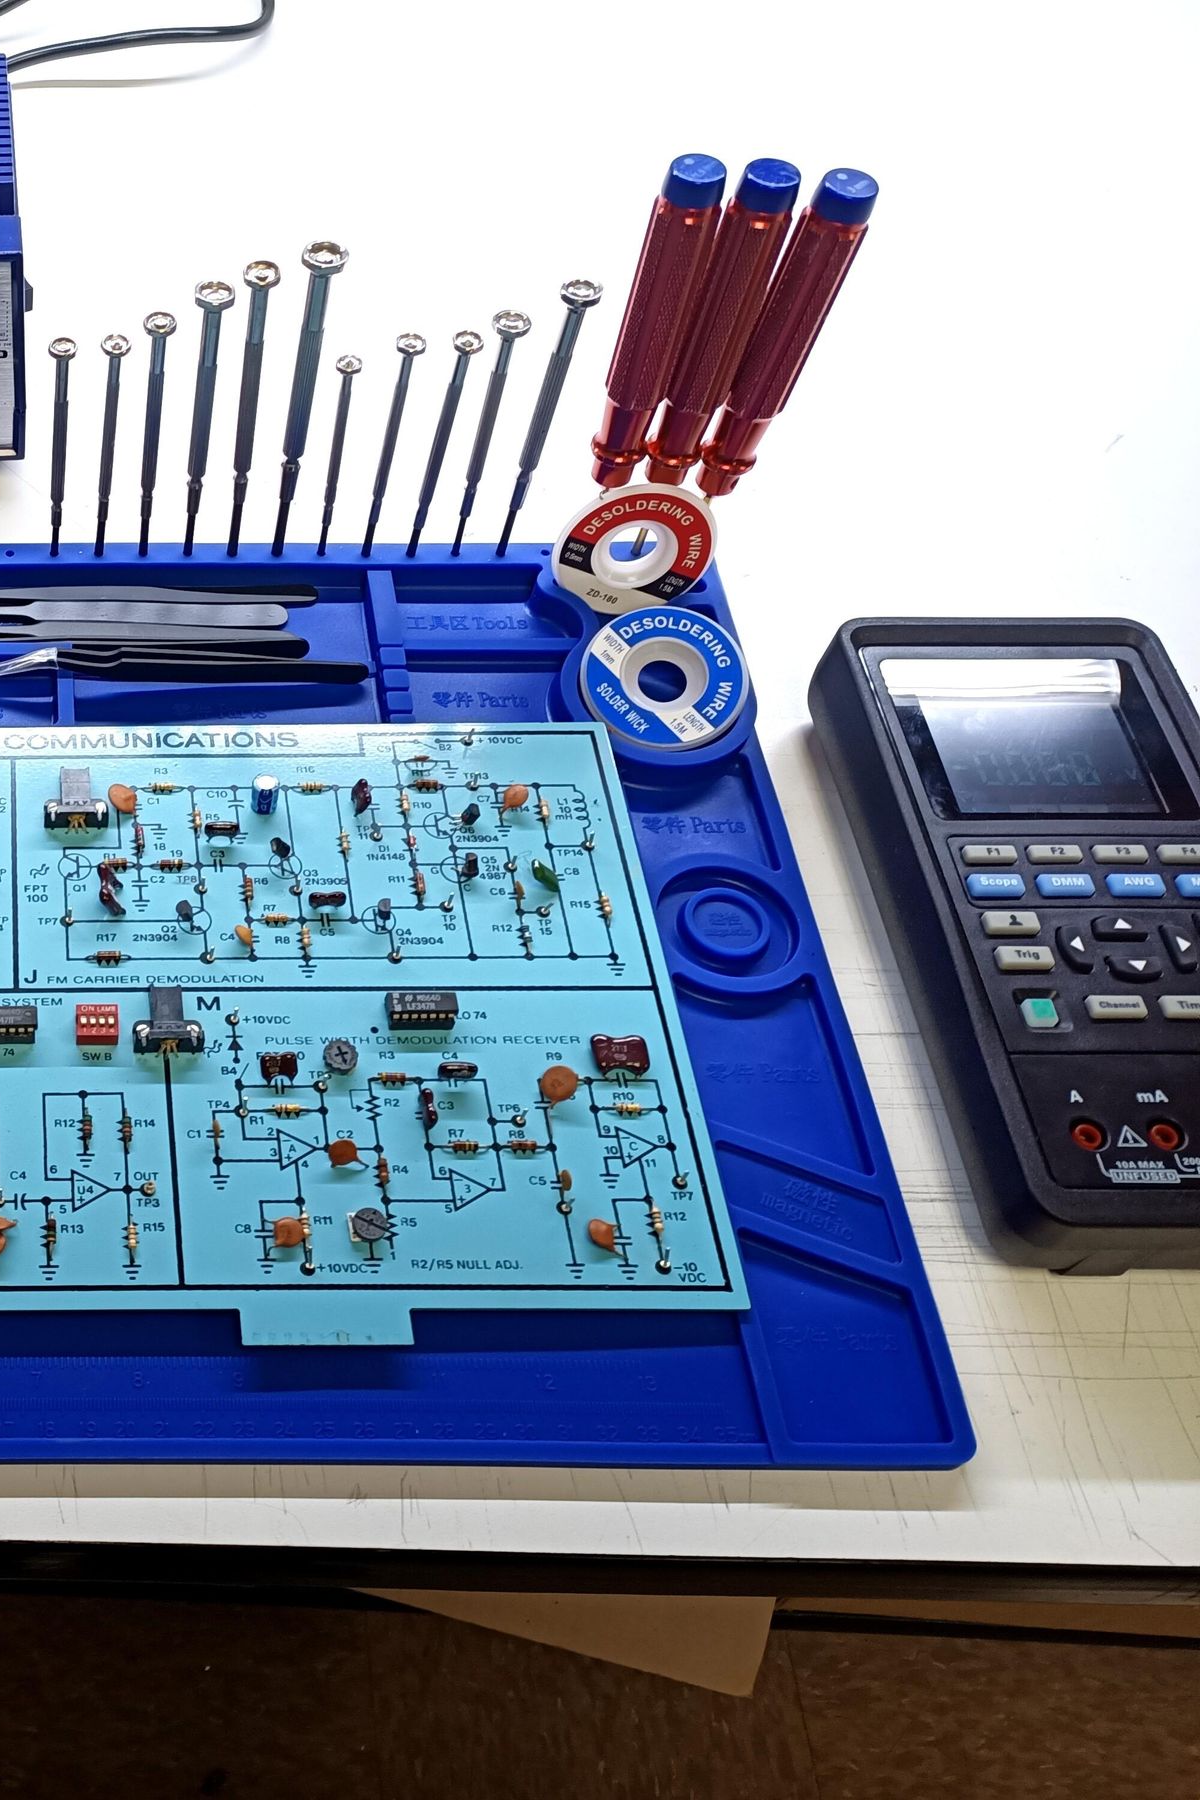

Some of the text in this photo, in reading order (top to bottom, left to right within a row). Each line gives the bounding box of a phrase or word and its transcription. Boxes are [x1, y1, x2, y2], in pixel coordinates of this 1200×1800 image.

[583, 500, 702, 569] DESOLDERING WIRE
[474, 615, 528, 631] Tools
[603, 633, 624, 655] WIDTH
[600, 649, 615, 665] 1mm
[619, 616, 734, 720] DESOLDERING WIRE
[478, 691, 529, 709] Parts
[597, 682, 650, 734] SOLDER WICK
[669, 718, 688, 736] 1.5M
[683, 712, 705, 732] LENGTH
[3, 731, 300, 749] COMMUNICATIONS
[206, 790, 228, 798] C10
[692, 814, 747, 834] Parts
[455, 835, 499, 843] 2N3904
[556, 849, 583, 857] TP14
[986, 847, 1001, 856] F1
[1050, 846, 1066, 855] F2
[1115, 846, 1131, 855] F3
[1182, 846, 1197, 855] F4
[366, 853, 406, 861] 1N4148
[479, 872, 506, 880] 4987
[980, 876, 1018, 887] Scope
[1052, 877, 1085, 887] DMM
[1123, 877, 1155, 887] AWG
[570, 900, 591, 909] R15
[96, 933, 117, 942] R17
[132, 934, 178, 942] 2N3904
[399, 937, 444, 945] 2N3904
[1015, 949, 1040, 960] Trig
[23, 969, 265, 984] J FM CARRIER DEMODULATION
[1, 997, 64, 1007] SYSTEM
[196, 996, 221, 1011] M
[1099, 1001, 1140, 1009] Channel
[242, 1016, 291, 1025] +10VDC
[265, 1036, 313, 1045] PULSE
[375, 1035, 497, 1046] DEMODULATION
[503, 1035, 581, 1044] RECEIVER
[81, 1052, 112, 1061] SW B
[1070, 1089, 1084, 1103] A
[1136, 1089, 1169, 1103] mA
[207, 1100, 230, 1109] TP4
[497, 1104, 521, 1113] TP6
[1115, 1160, 1165, 1169] 10A MAX
[133, 1171, 158, 1181] OUT
[1113, 1172, 1177, 1181] UNFUSED
[670, 1191, 694, 1201] TP7
[664, 1212, 687, 1222] R12
[60, 1224, 84, 1234] R13
[317, 1264, 367, 1273] +10VDC
[457, 1260, 492, 1270] NULL
[494, 1260, 523, 1271] ADJ.
